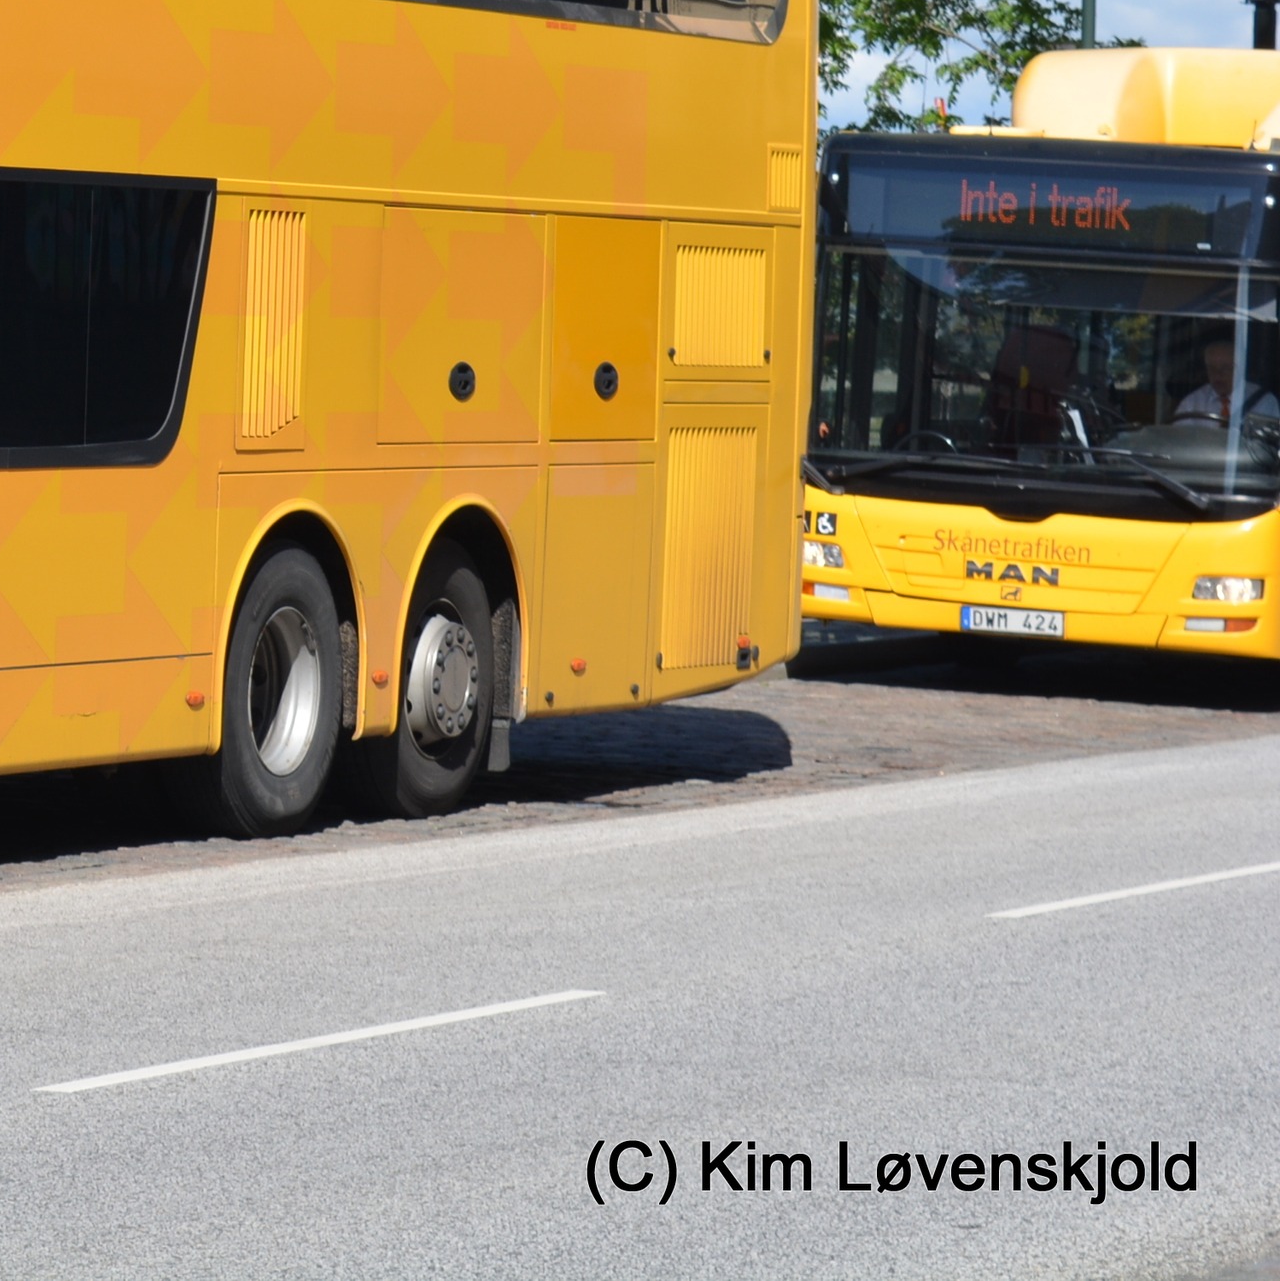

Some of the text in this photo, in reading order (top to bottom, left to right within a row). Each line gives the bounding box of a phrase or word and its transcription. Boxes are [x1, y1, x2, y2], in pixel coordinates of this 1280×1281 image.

[960, 179, 1132, 231] Inte i trafik
[933, 528, 1091, 564] Skånetrafiken
[966, 560, 1059, 587] MAN
[973, 610, 1058, 632] DWM 424
